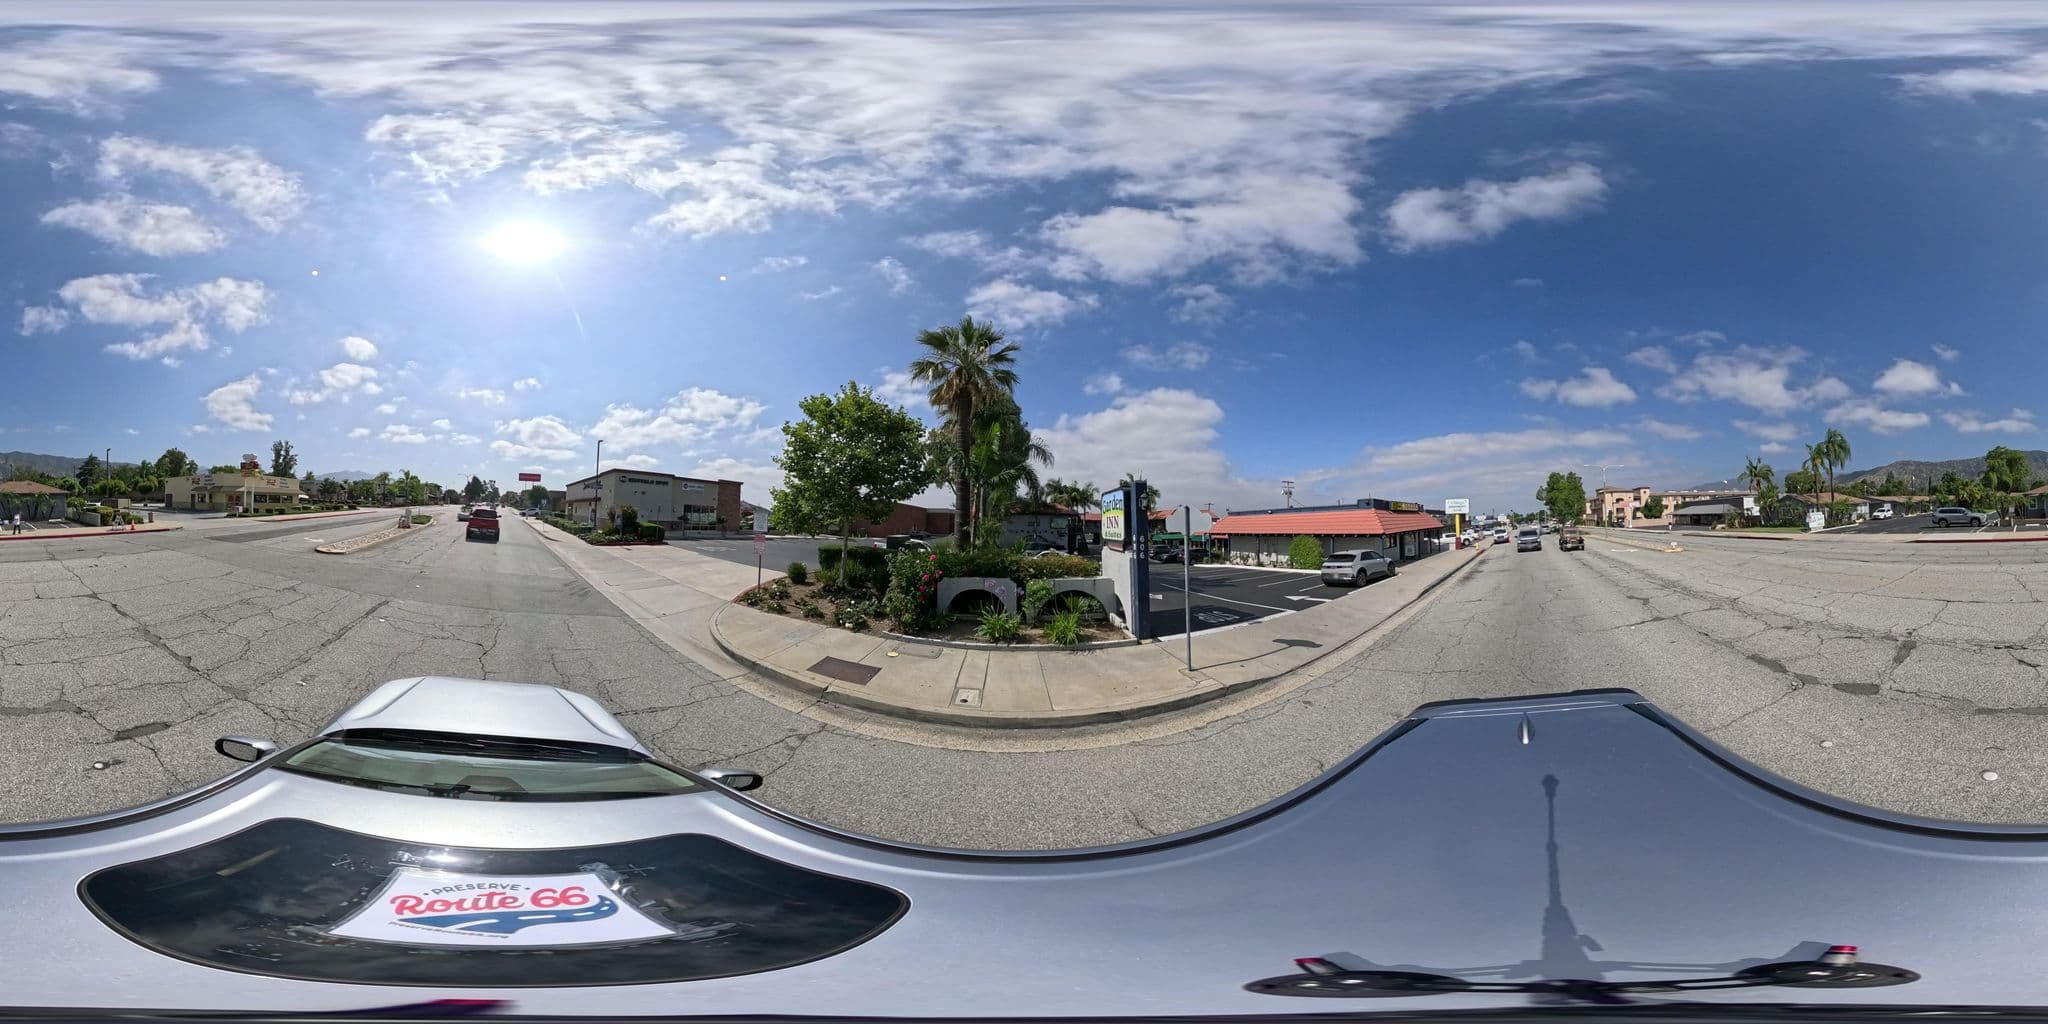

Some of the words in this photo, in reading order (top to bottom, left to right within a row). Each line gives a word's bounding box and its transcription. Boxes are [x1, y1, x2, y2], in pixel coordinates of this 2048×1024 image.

[1103, 494, 1123, 514] Garden
[1106, 516, 1119, 529] INN
[431, 882, 521, 896] PRESERVE
[390, 891, 525, 915] Route
[529, 886, 590, 908] 66
